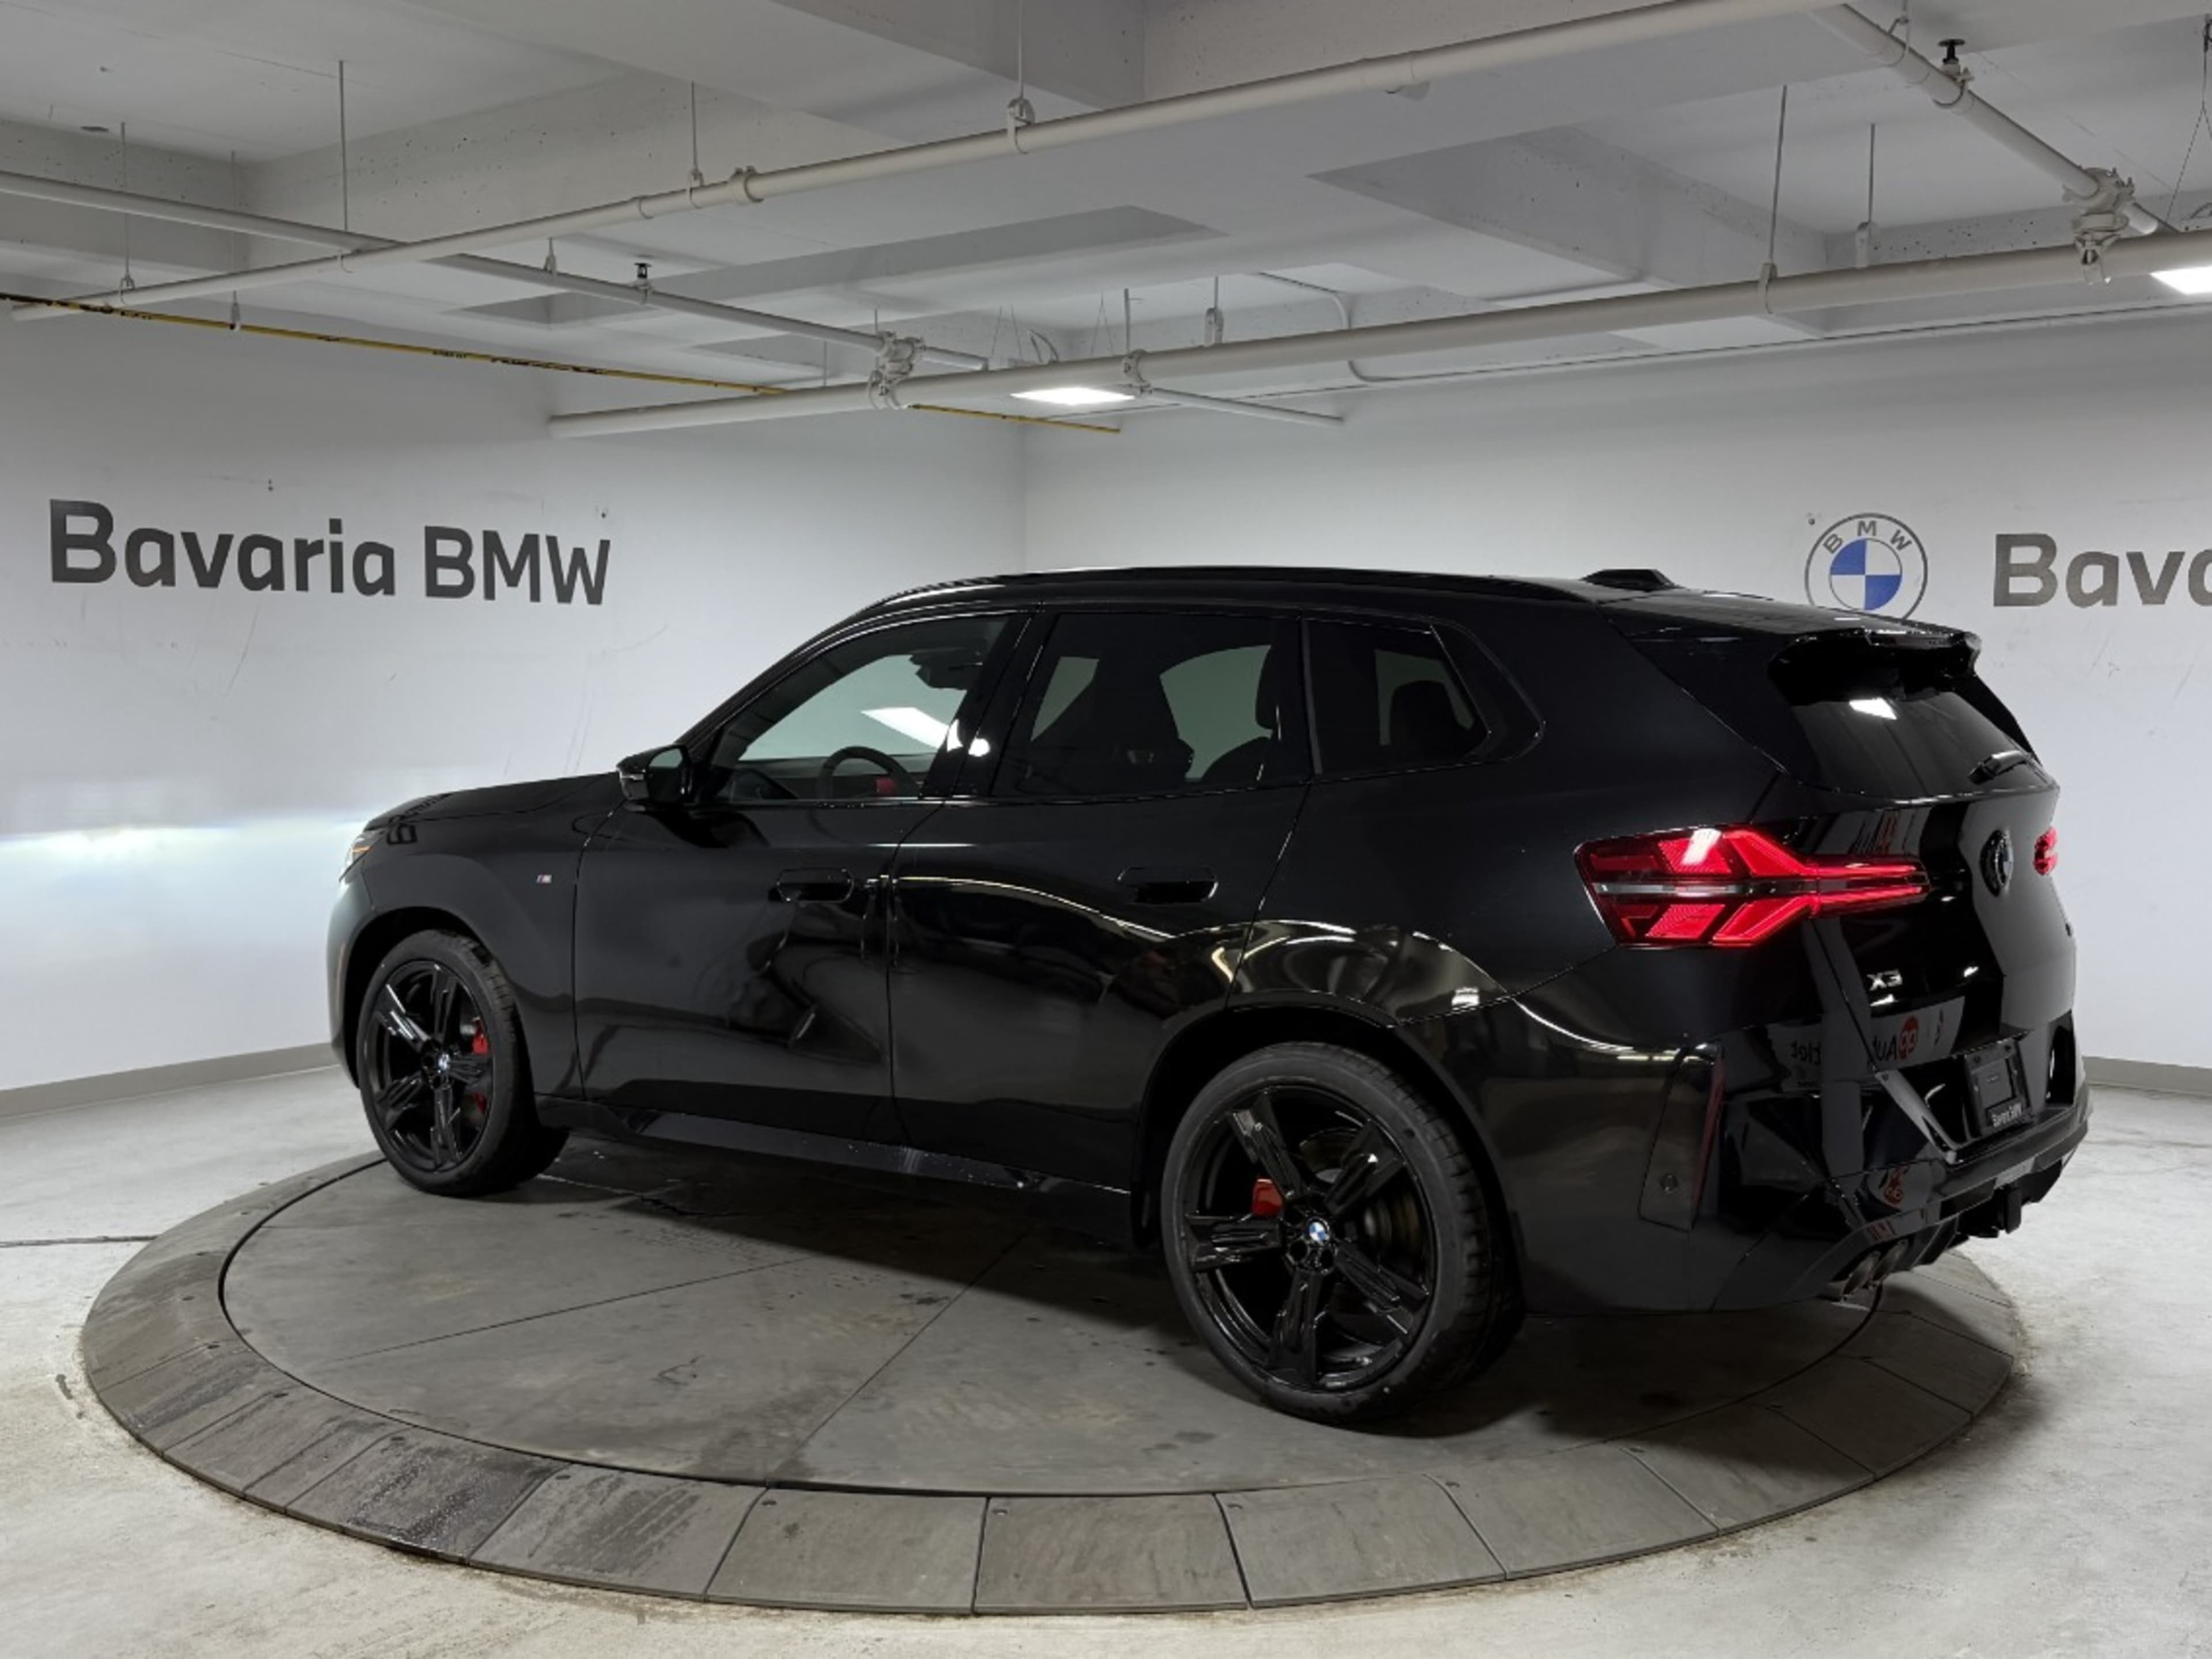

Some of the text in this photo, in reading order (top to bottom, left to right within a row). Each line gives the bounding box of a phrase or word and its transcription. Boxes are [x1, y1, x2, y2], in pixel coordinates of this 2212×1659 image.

[49, 499, 611, 605] Bavaria BMW
[1823, 520, 1912, 555] BMW
